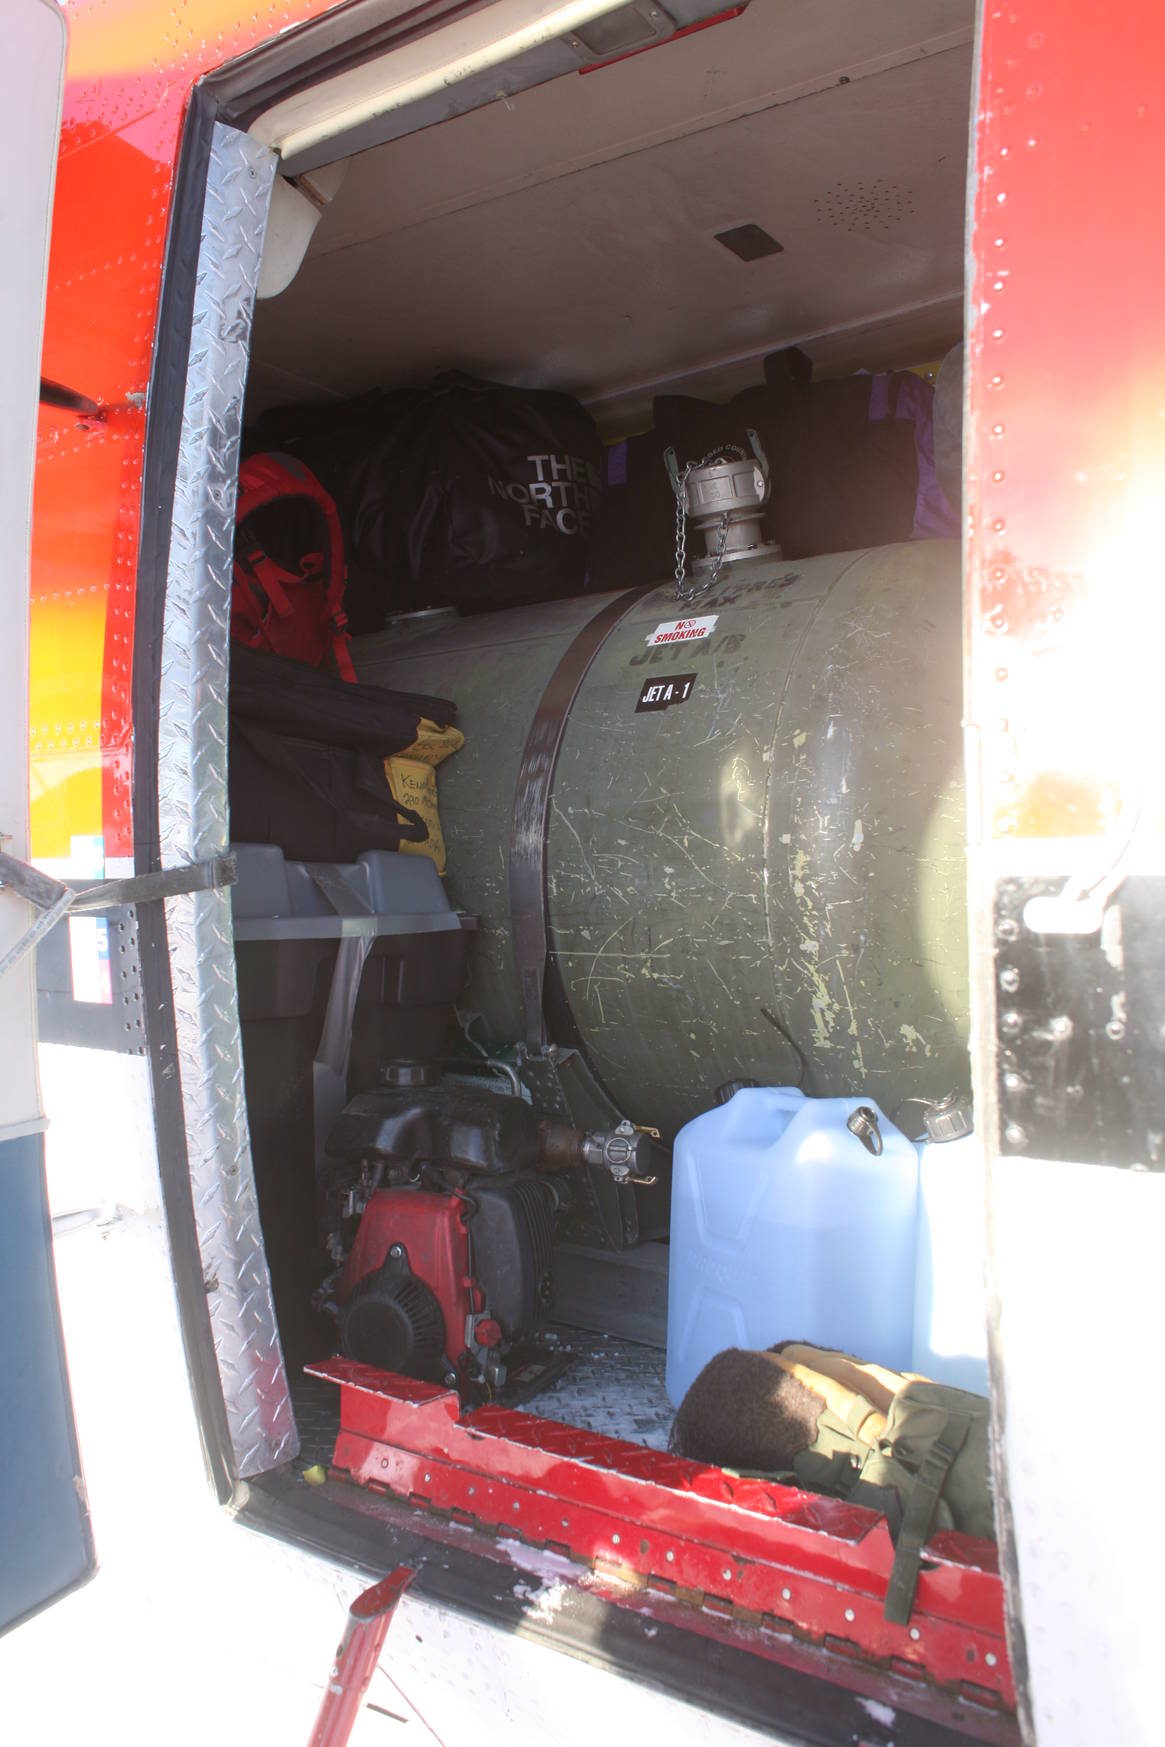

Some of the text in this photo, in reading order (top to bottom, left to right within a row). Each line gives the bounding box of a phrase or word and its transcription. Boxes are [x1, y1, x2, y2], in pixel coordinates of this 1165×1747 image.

[527, 454, 585, 482] THE
[488, 475, 591, 511] NORTH
[521, 504, 590, 536] FACE
[654, 627, 707, 643] SMOKING
[642, 685, 666, 703] JET
